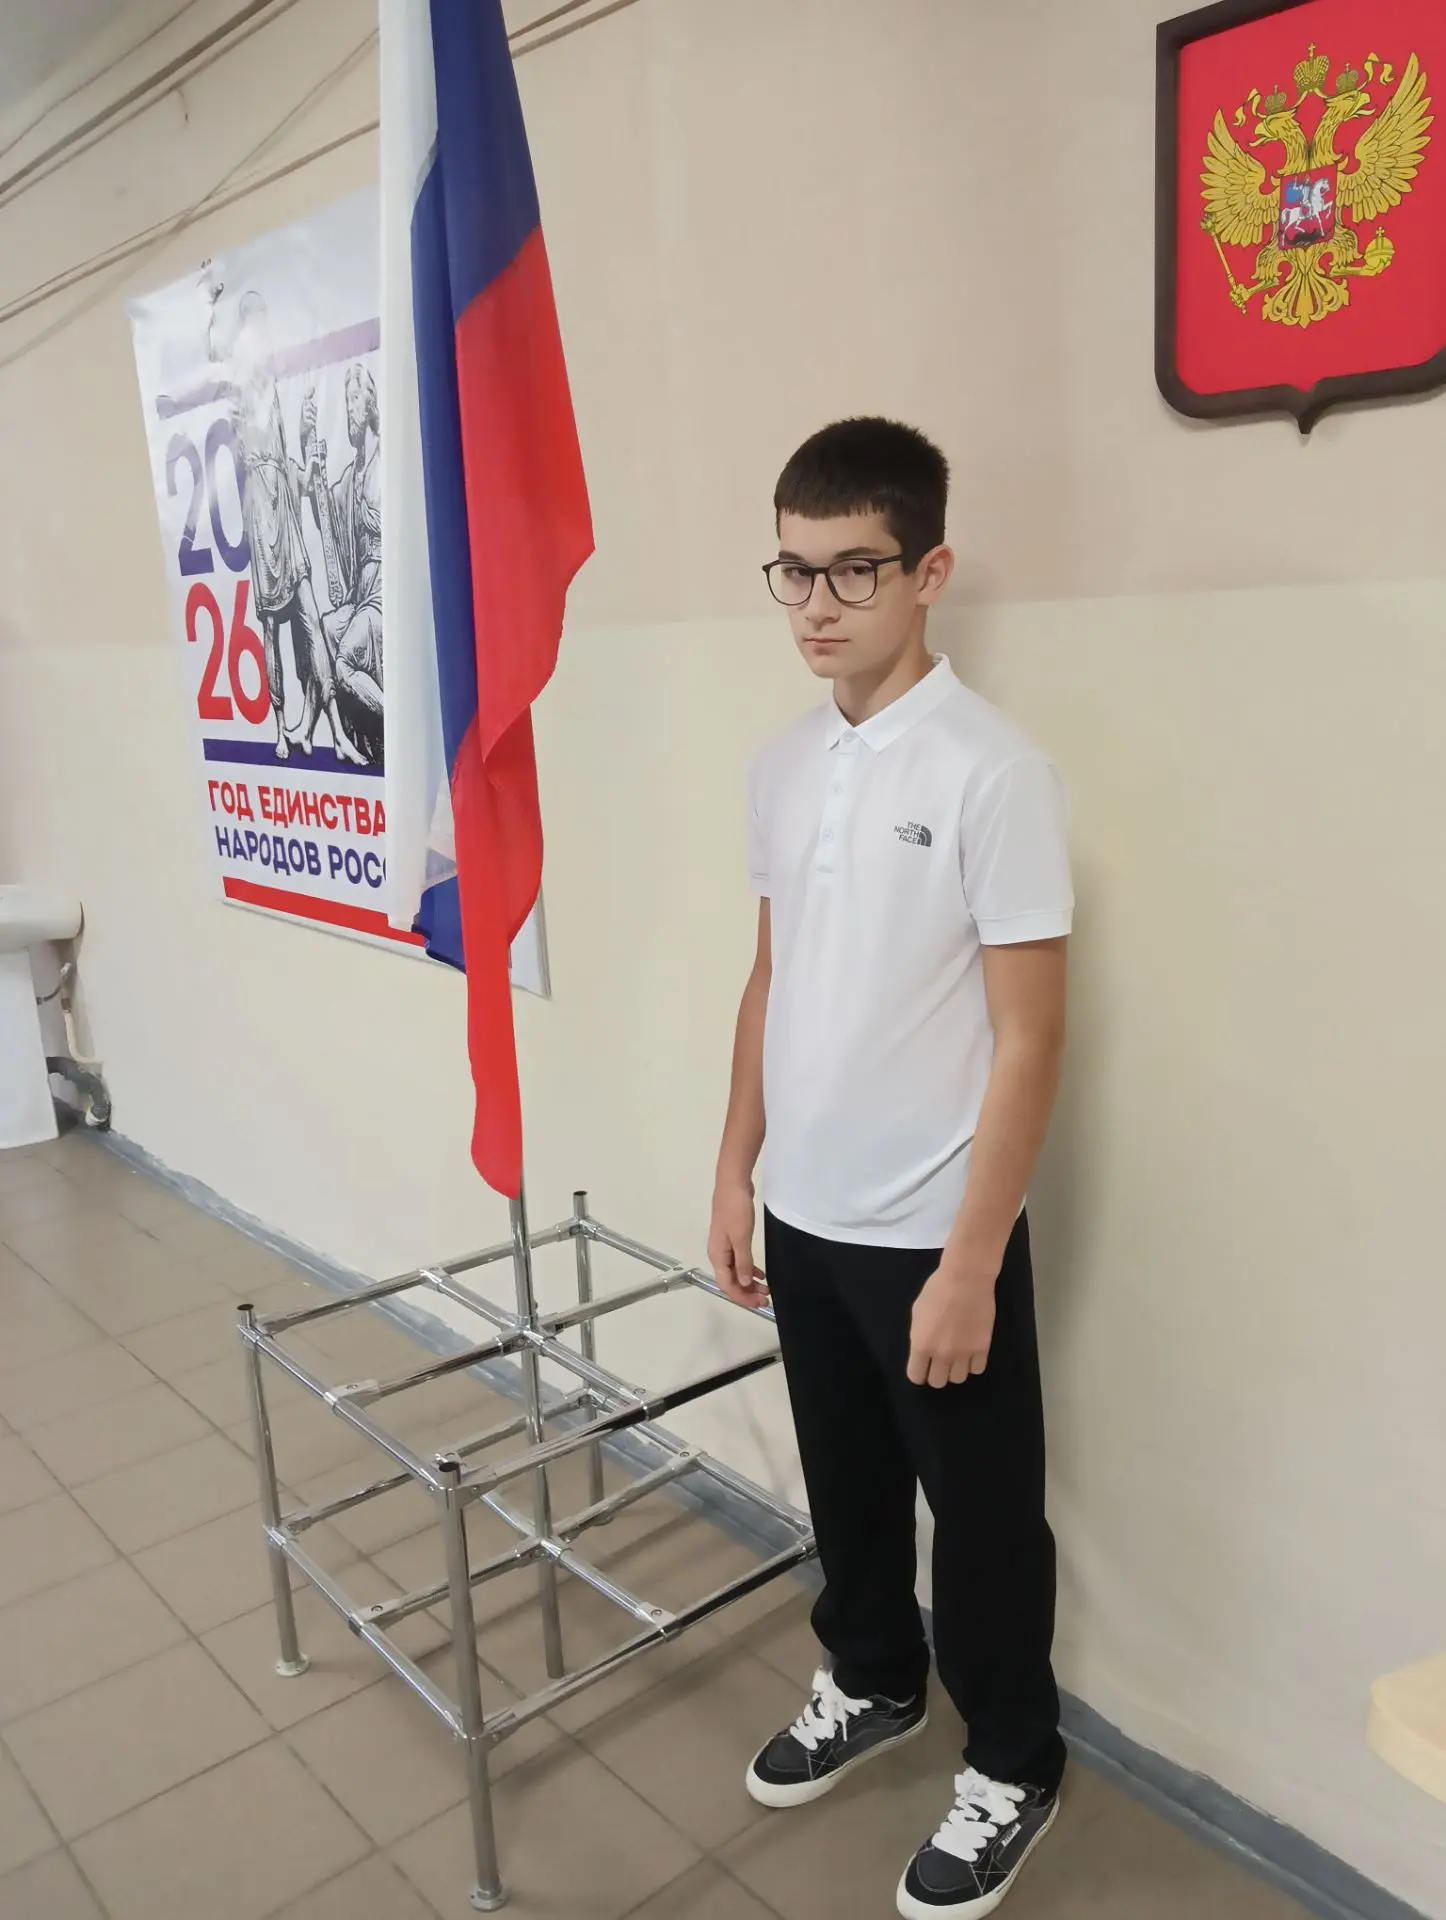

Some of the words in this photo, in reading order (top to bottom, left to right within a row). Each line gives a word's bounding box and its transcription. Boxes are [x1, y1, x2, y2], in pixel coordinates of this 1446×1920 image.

[166, 418, 250, 575] 20
[185, 580, 271, 724] 26
[208, 780, 254, 822] ГОД
[258, 785, 386, 837] ЕДИНСТВА
[894, 825, 920, 838] NORTH
[907, 821, 921, 831] THE
[215, 826, 322, 876] НАРОДОВ
[327, 844, 386, 889] РОС
[899, 834, 917, 845] FACE
